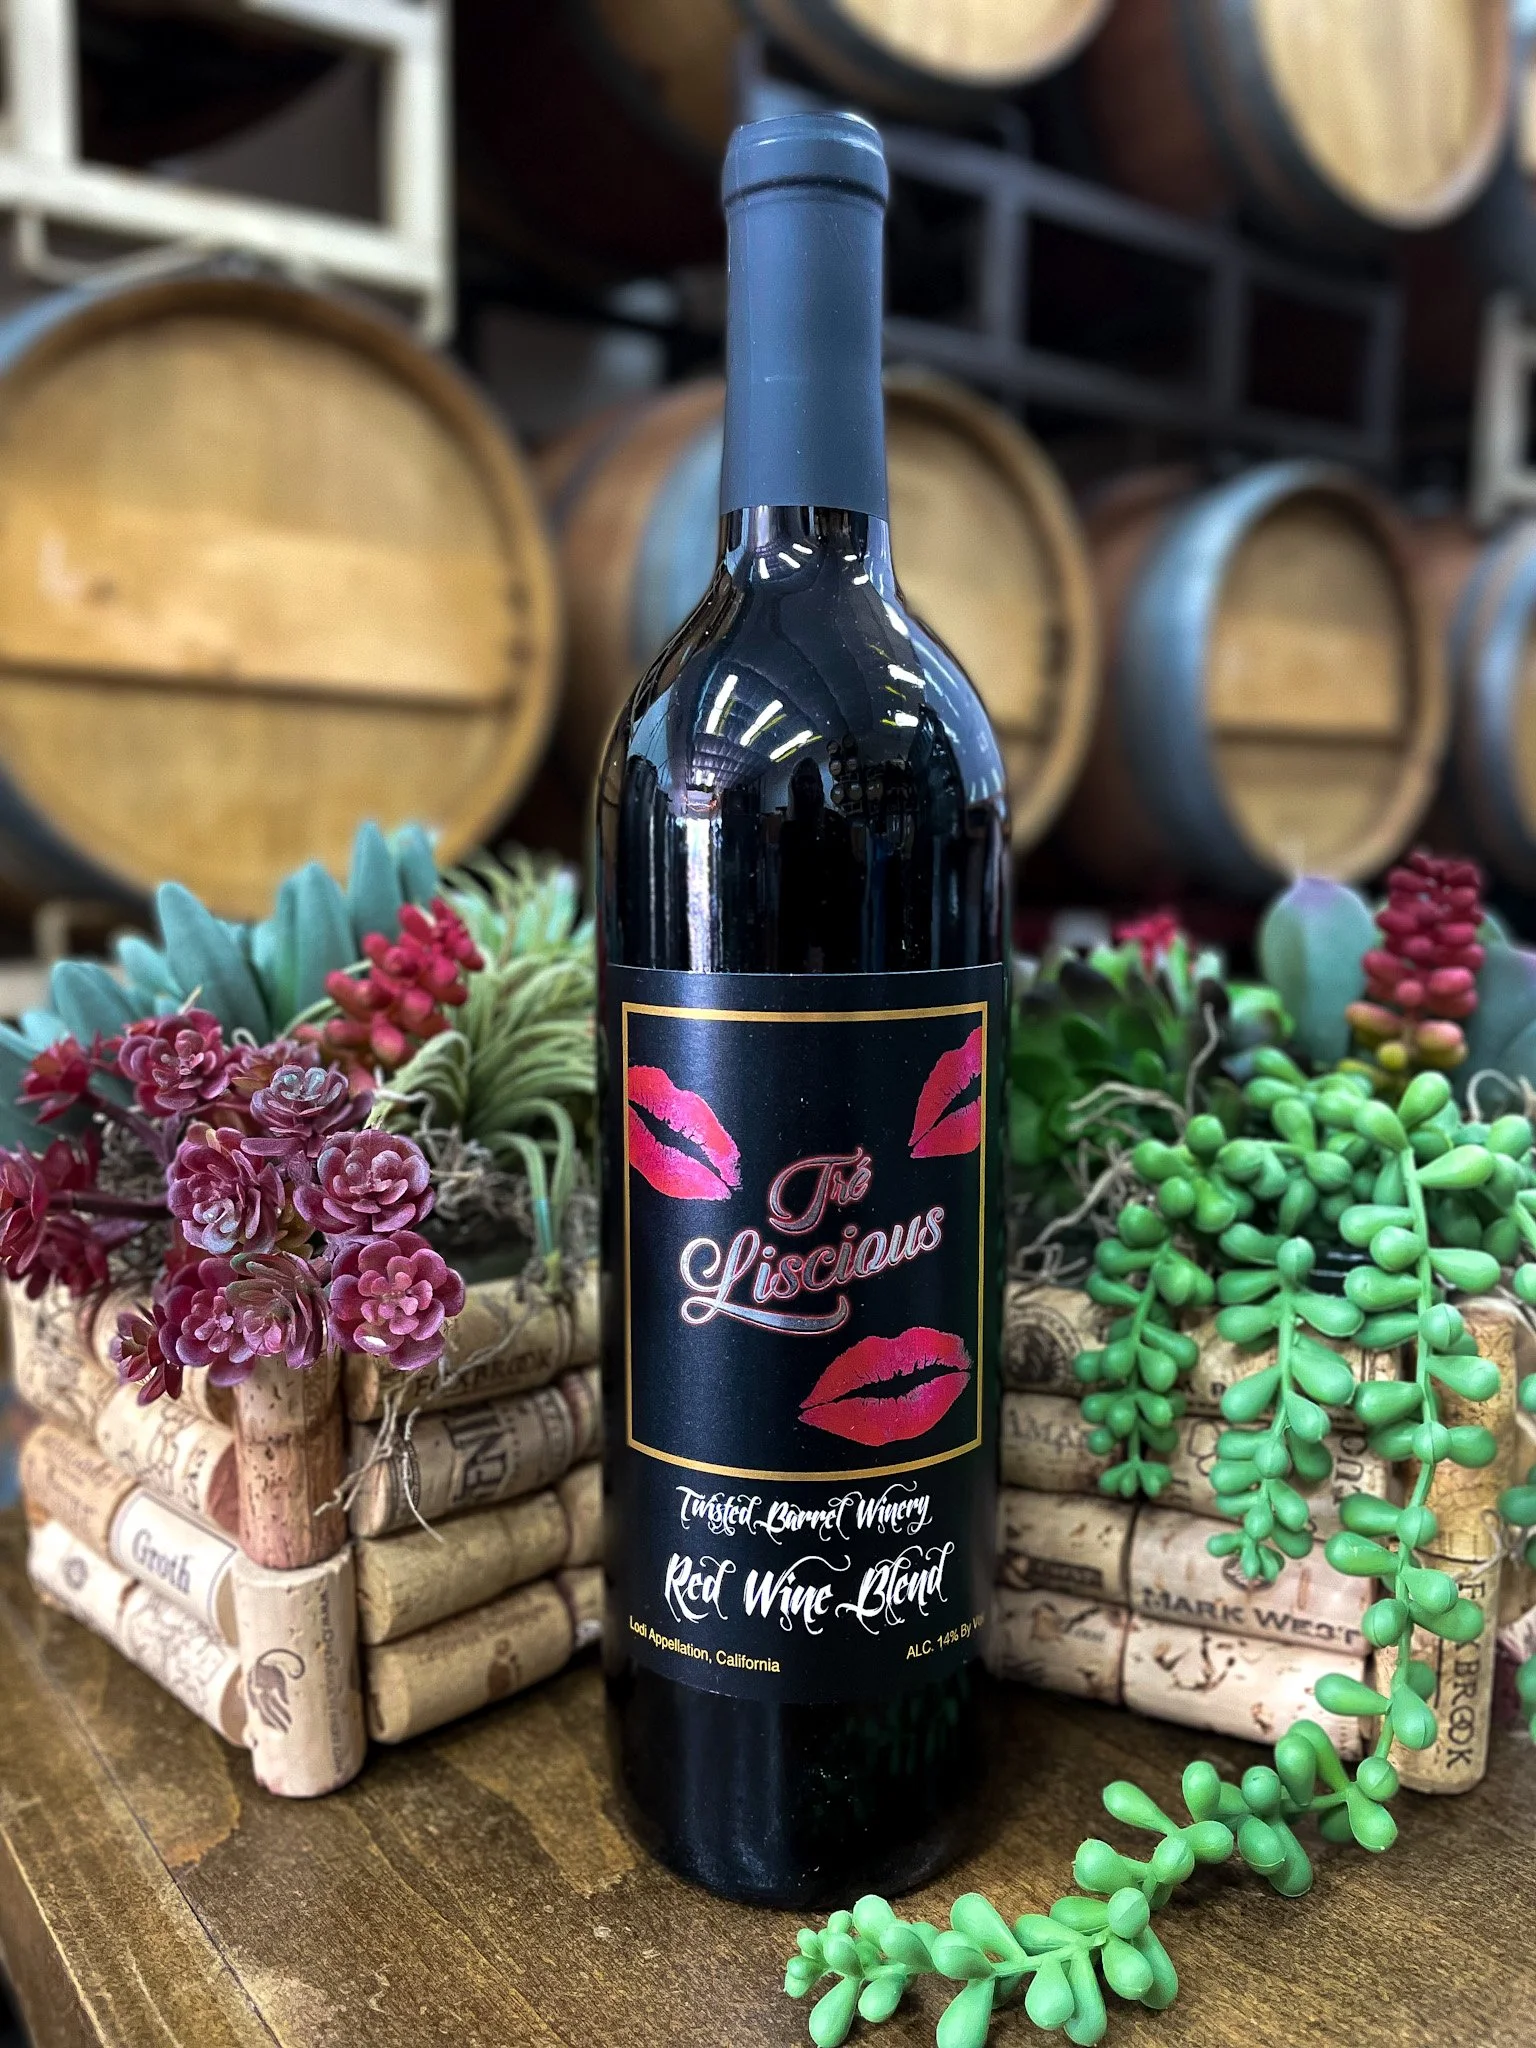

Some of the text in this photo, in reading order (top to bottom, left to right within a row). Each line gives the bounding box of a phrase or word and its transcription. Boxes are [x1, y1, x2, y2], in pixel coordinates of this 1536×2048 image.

[678, 1205, 946, 1335] Liscious
[675, 1480, 933, 1545] Twisted Barrel Winery
[131, 1528, 192, 1595] Groth
[664, 1541, 955, 1635] Red Wine Blend
[629, 1615, 781, 1673] Lodi Appellation, California
[906, 1639, 935, 1660] ALC.
[936, 1627, 960, 1649] 14%
[960, 1622, 972, 1638] By
[1141, 1586, 1363, 1646] MARK WEST
